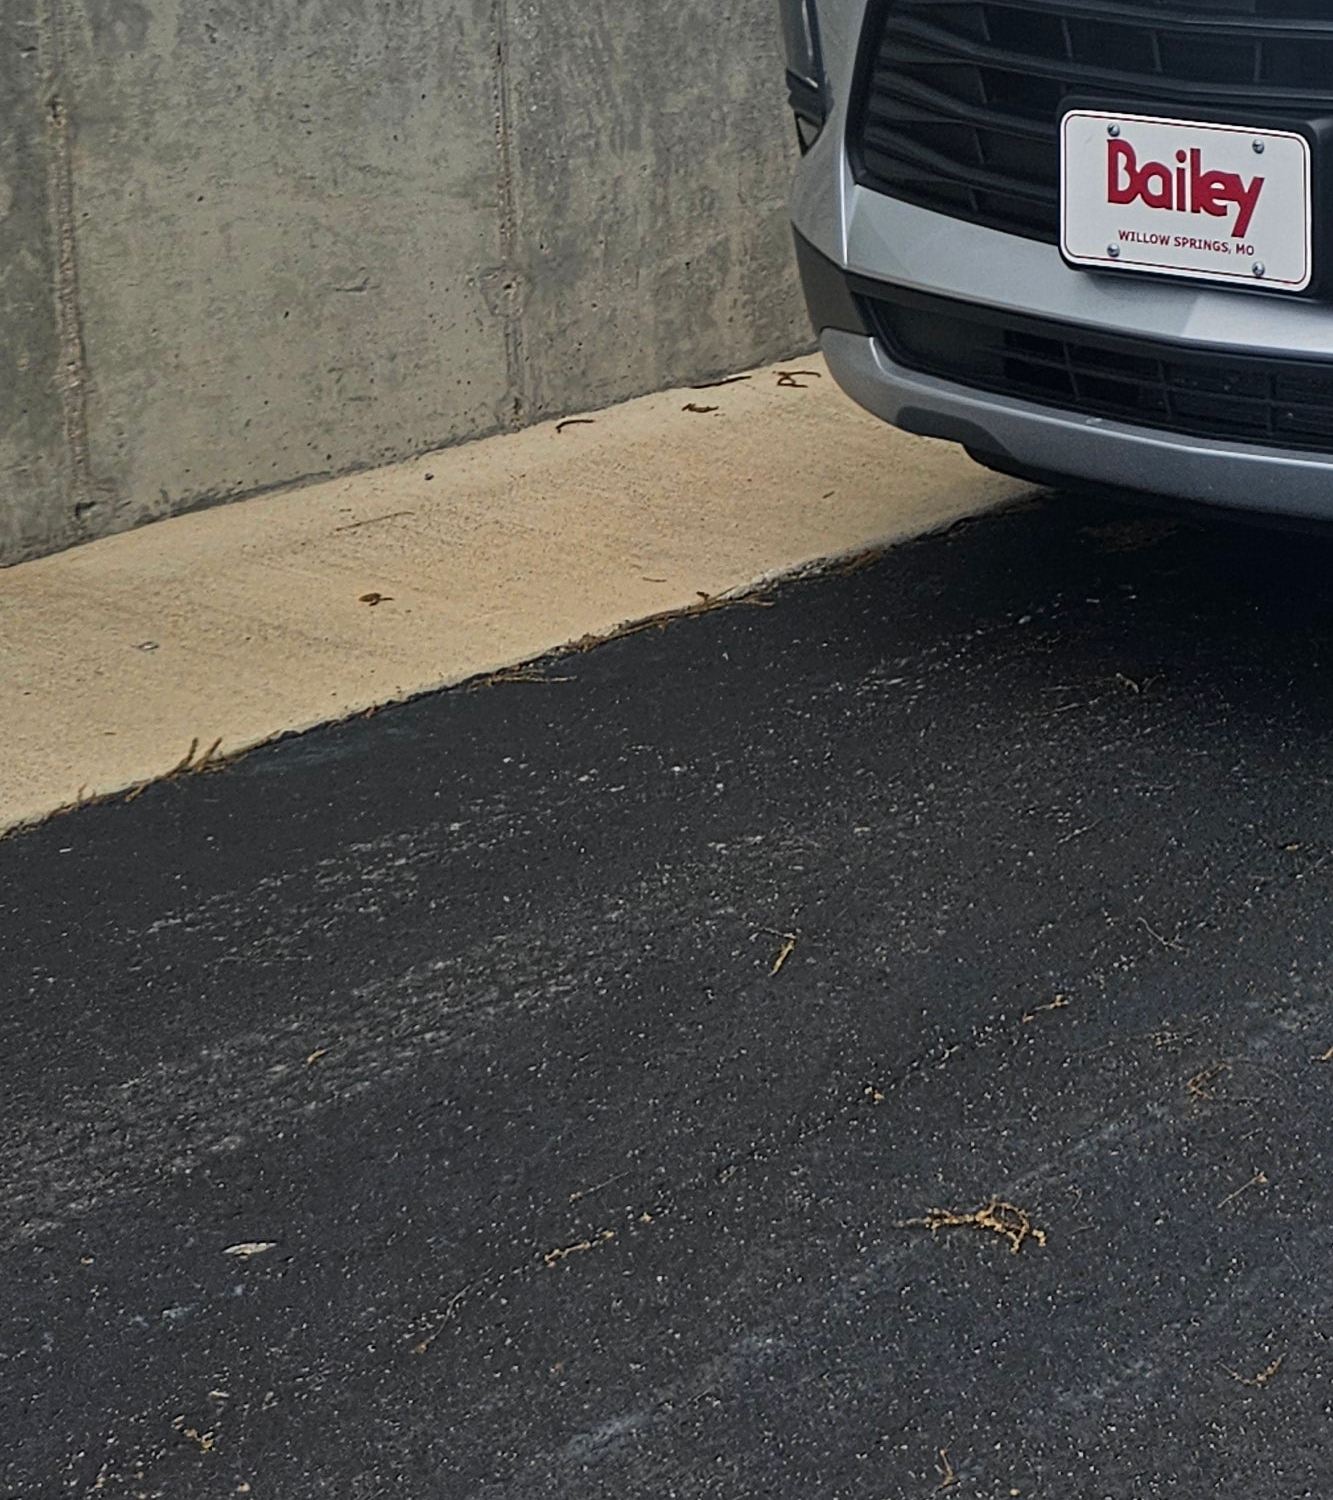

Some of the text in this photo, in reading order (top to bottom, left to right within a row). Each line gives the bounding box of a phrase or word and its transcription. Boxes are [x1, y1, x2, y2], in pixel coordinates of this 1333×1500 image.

[1107, 138, 1264, 238] Bailey
[1118, 229, 1255, 256] WILLOW SPRINGS, MO
